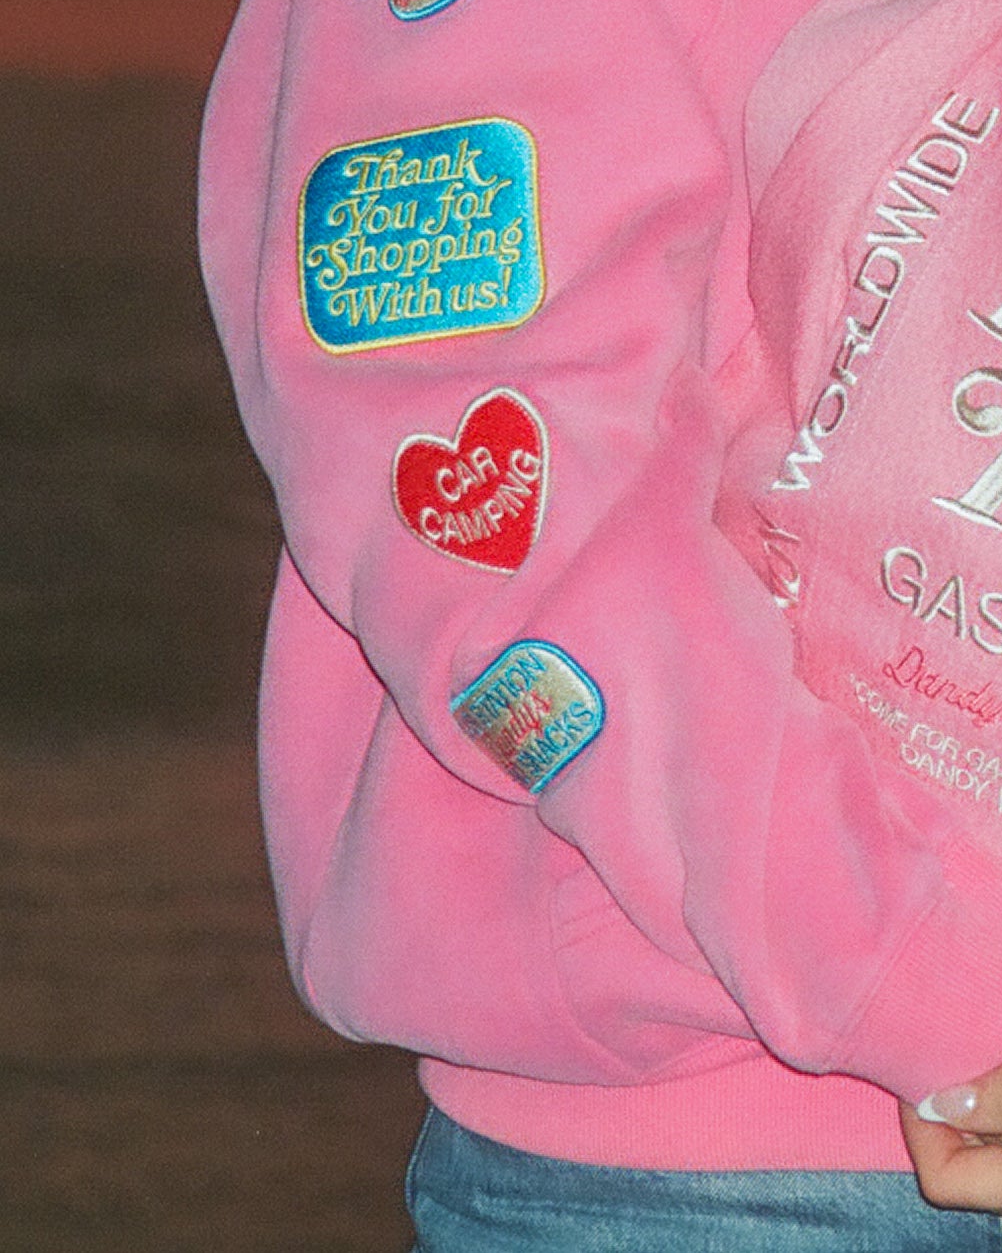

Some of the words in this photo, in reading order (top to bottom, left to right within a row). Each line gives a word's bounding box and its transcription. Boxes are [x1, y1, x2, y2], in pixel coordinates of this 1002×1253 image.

[344, 138, 498, 195] Thank
[327, 193, 419, 238] You
[422, 179, 513, 236] for
[306, 216, 525, 291] Shopping
[327, 277, 444, 327] With
[451, 266, 513, 312] us!
[769, 92, 999, 491] WORLDWIDE
[420, 449, 541, 546] CAMPING
[435, 446, 500, 503] CAR
[516, 701, 596, 776] SNACKS
[909, 722, 961, 761] FOR
[901, 742, 991, 801] DANDY
